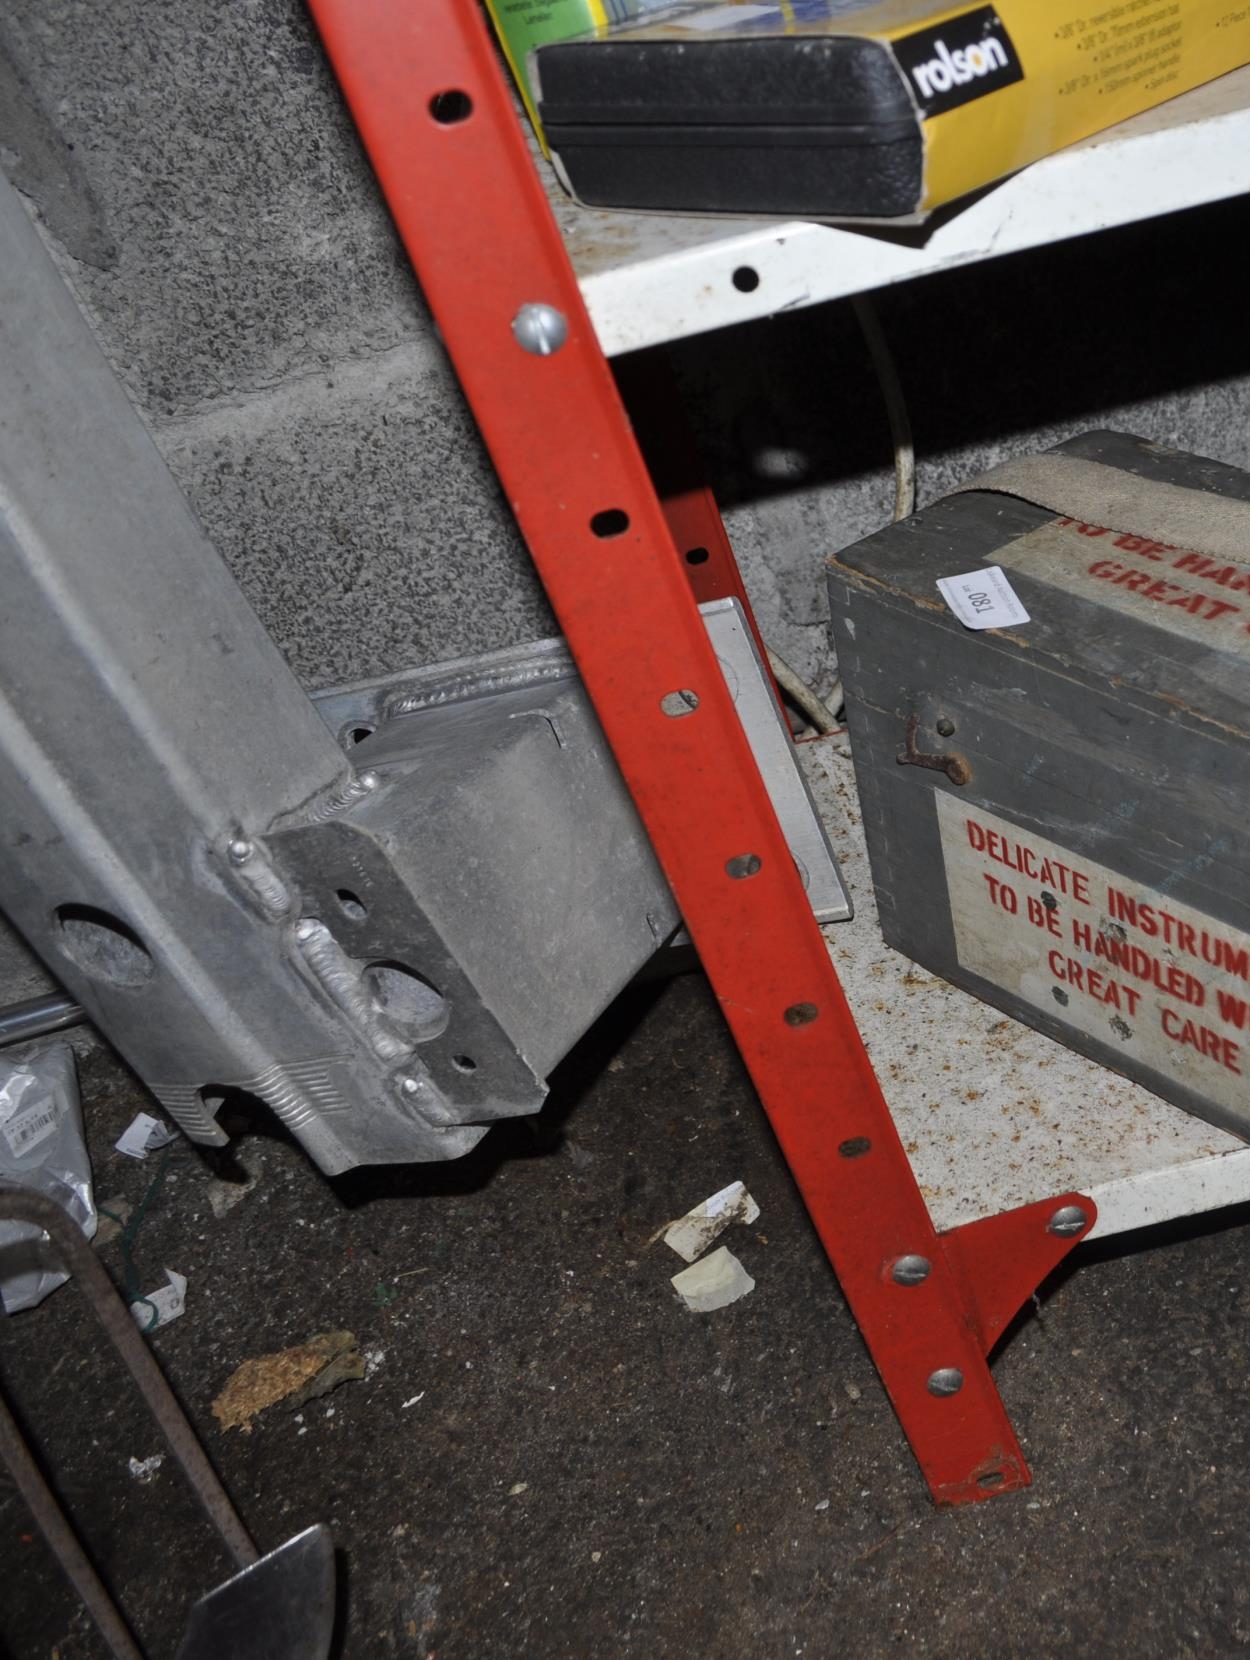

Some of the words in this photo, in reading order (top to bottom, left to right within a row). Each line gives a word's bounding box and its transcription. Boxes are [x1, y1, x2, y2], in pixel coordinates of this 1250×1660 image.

[912, 37, 1009, 98] rolson
[968, 592, 995, 614] 081
[1087, 560, 1242, 621] GREAT
[966, 818, 1091, 906] DELICATE
[983, 872, 1019, 915] TO
[1026, 894, 1063, 939] BE
[1071, 919, 1207, 1009] HANDLED
[1047, 948, 1142, 1017] GREAT
[1161, 1006, 1243, 1075] CARE
